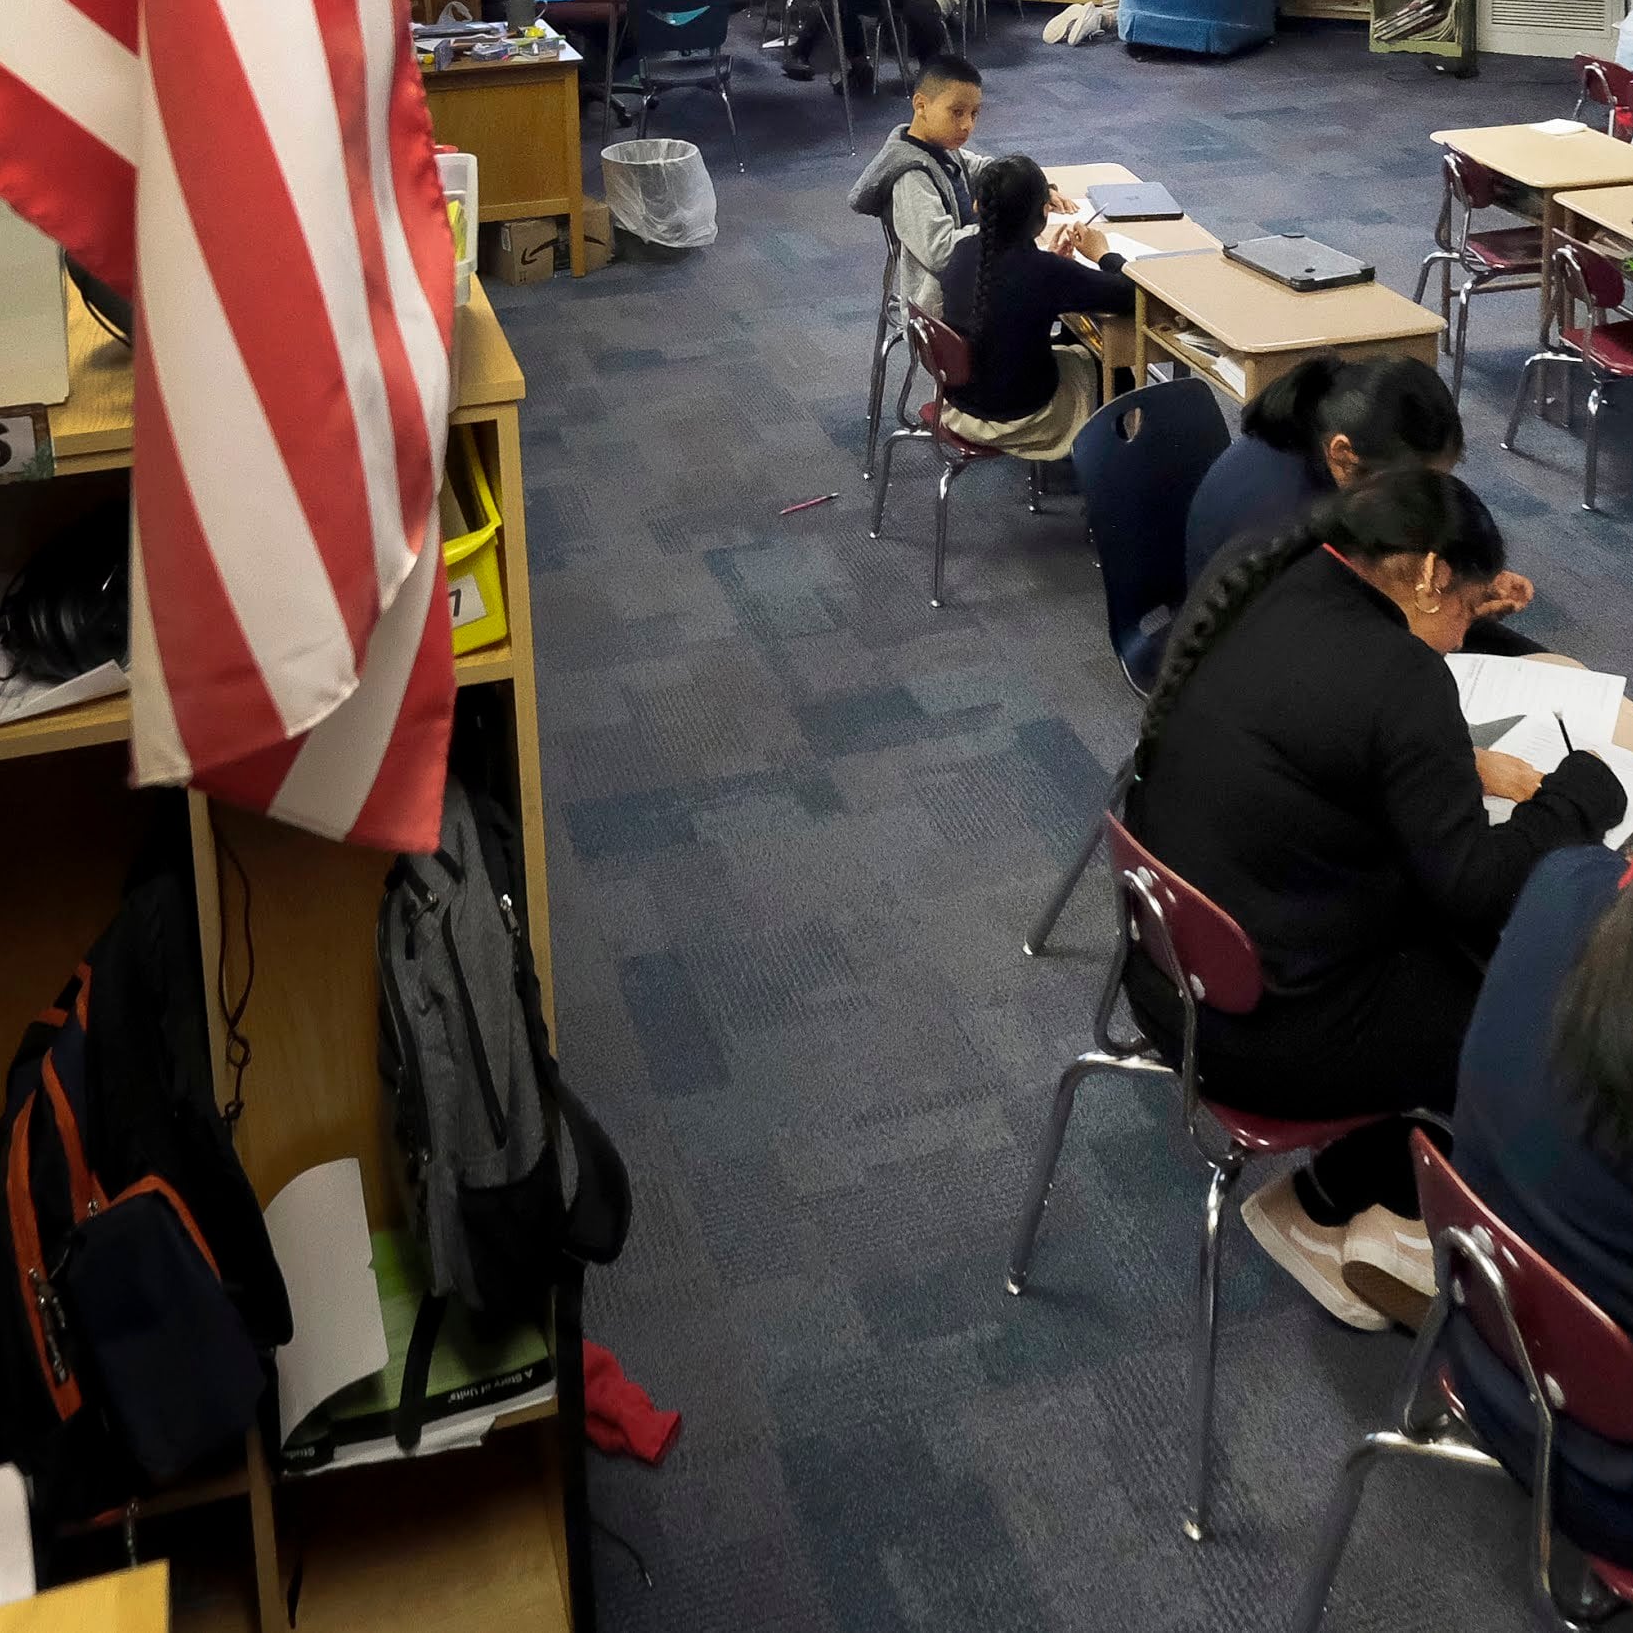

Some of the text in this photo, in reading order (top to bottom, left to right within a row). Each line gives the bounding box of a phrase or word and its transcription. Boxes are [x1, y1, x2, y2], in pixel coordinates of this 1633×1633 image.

[493, 1372, 523, 1389] Story
[524, 1368, 533, 1380] A
[478, 1381, 493, 1394] of
